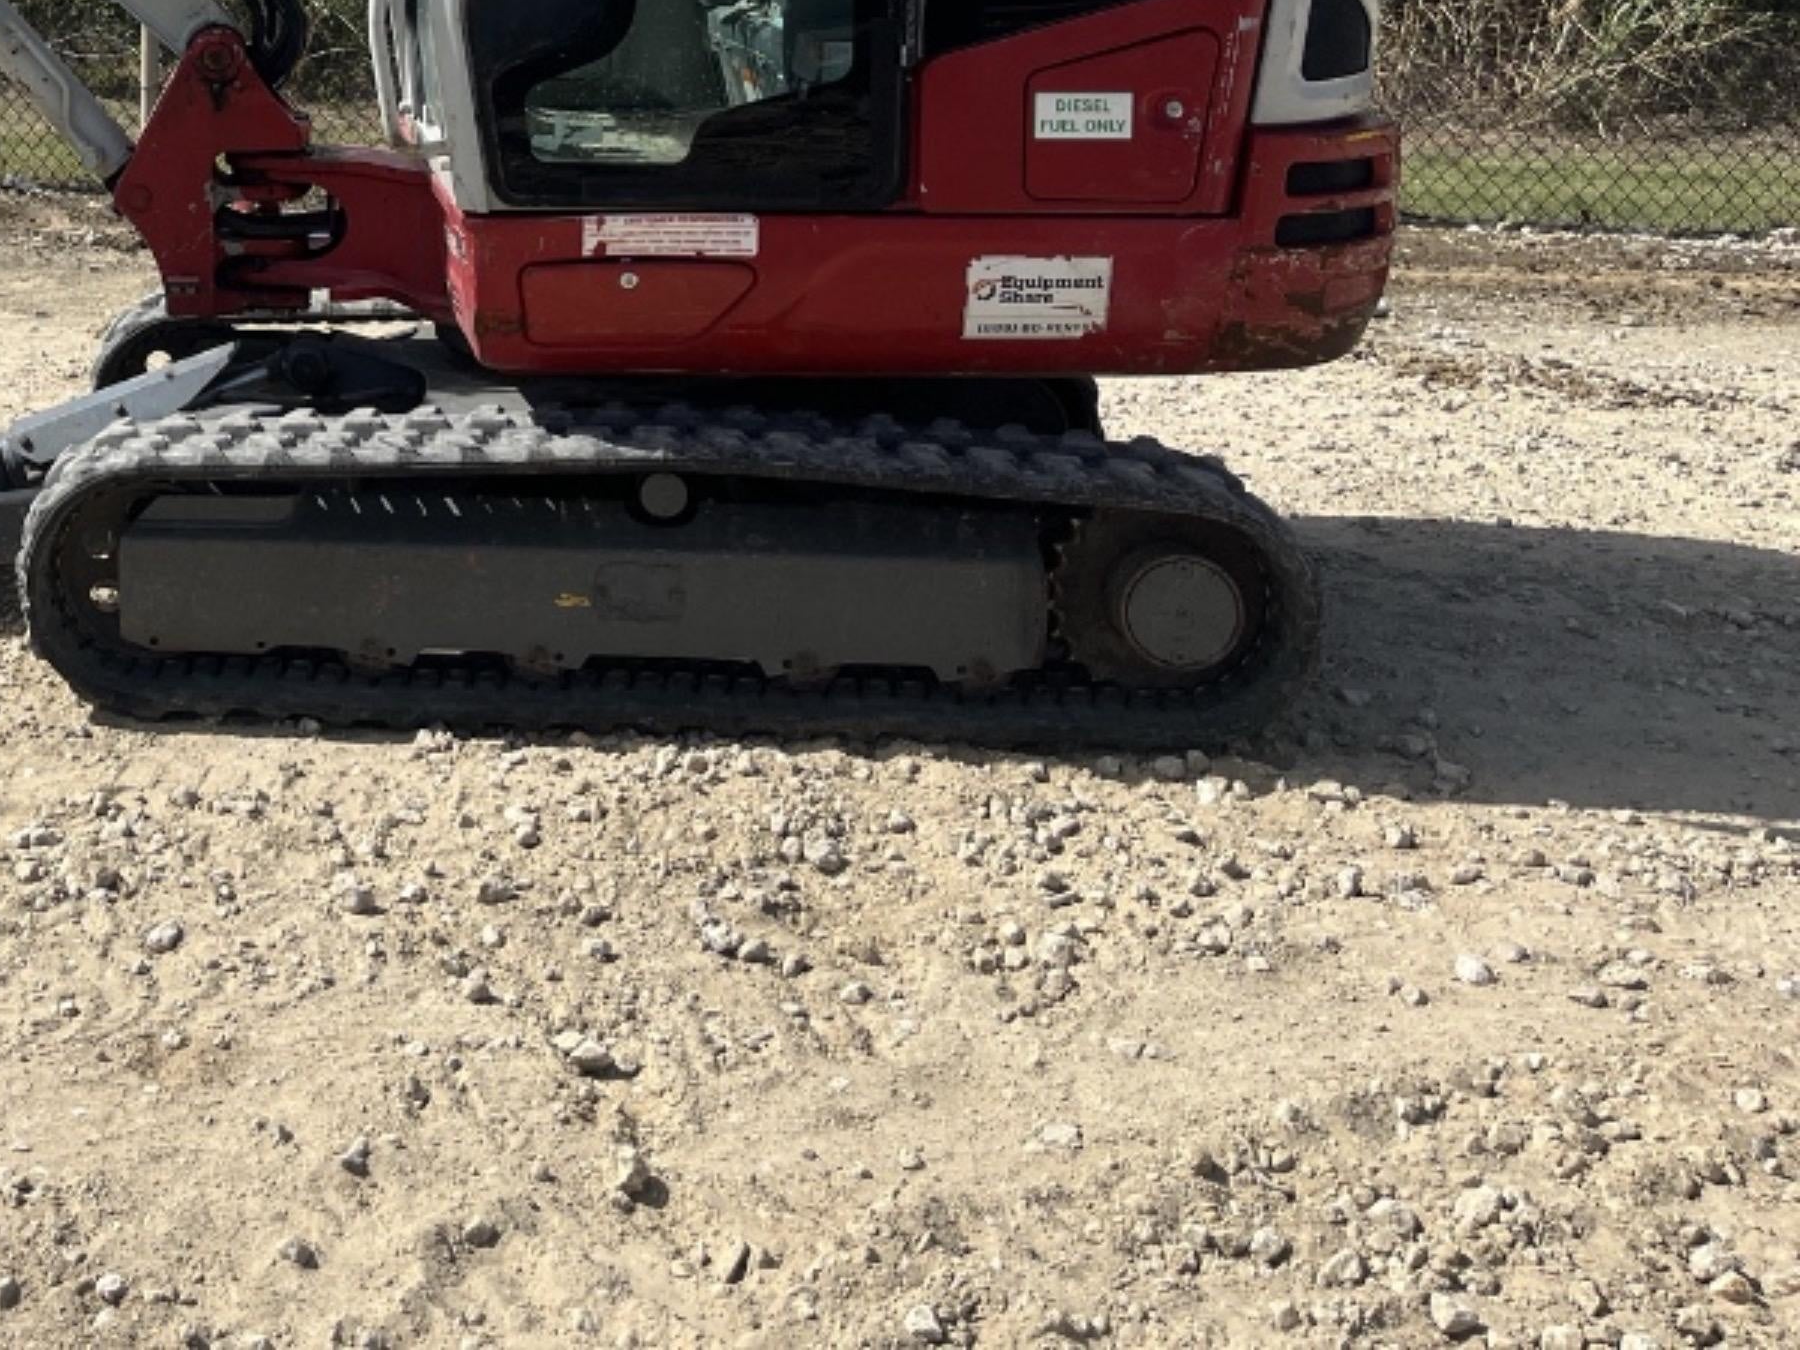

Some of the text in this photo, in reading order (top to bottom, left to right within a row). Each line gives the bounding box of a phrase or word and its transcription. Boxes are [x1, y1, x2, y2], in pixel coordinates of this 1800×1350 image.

[1055, 97, 1111, 112] DIESEL
[1040, 119, 1126, 133] FUEL ONLY
[1000, 275, 1105, 291] Equipment
[999, 291, 1054, 304] Share
